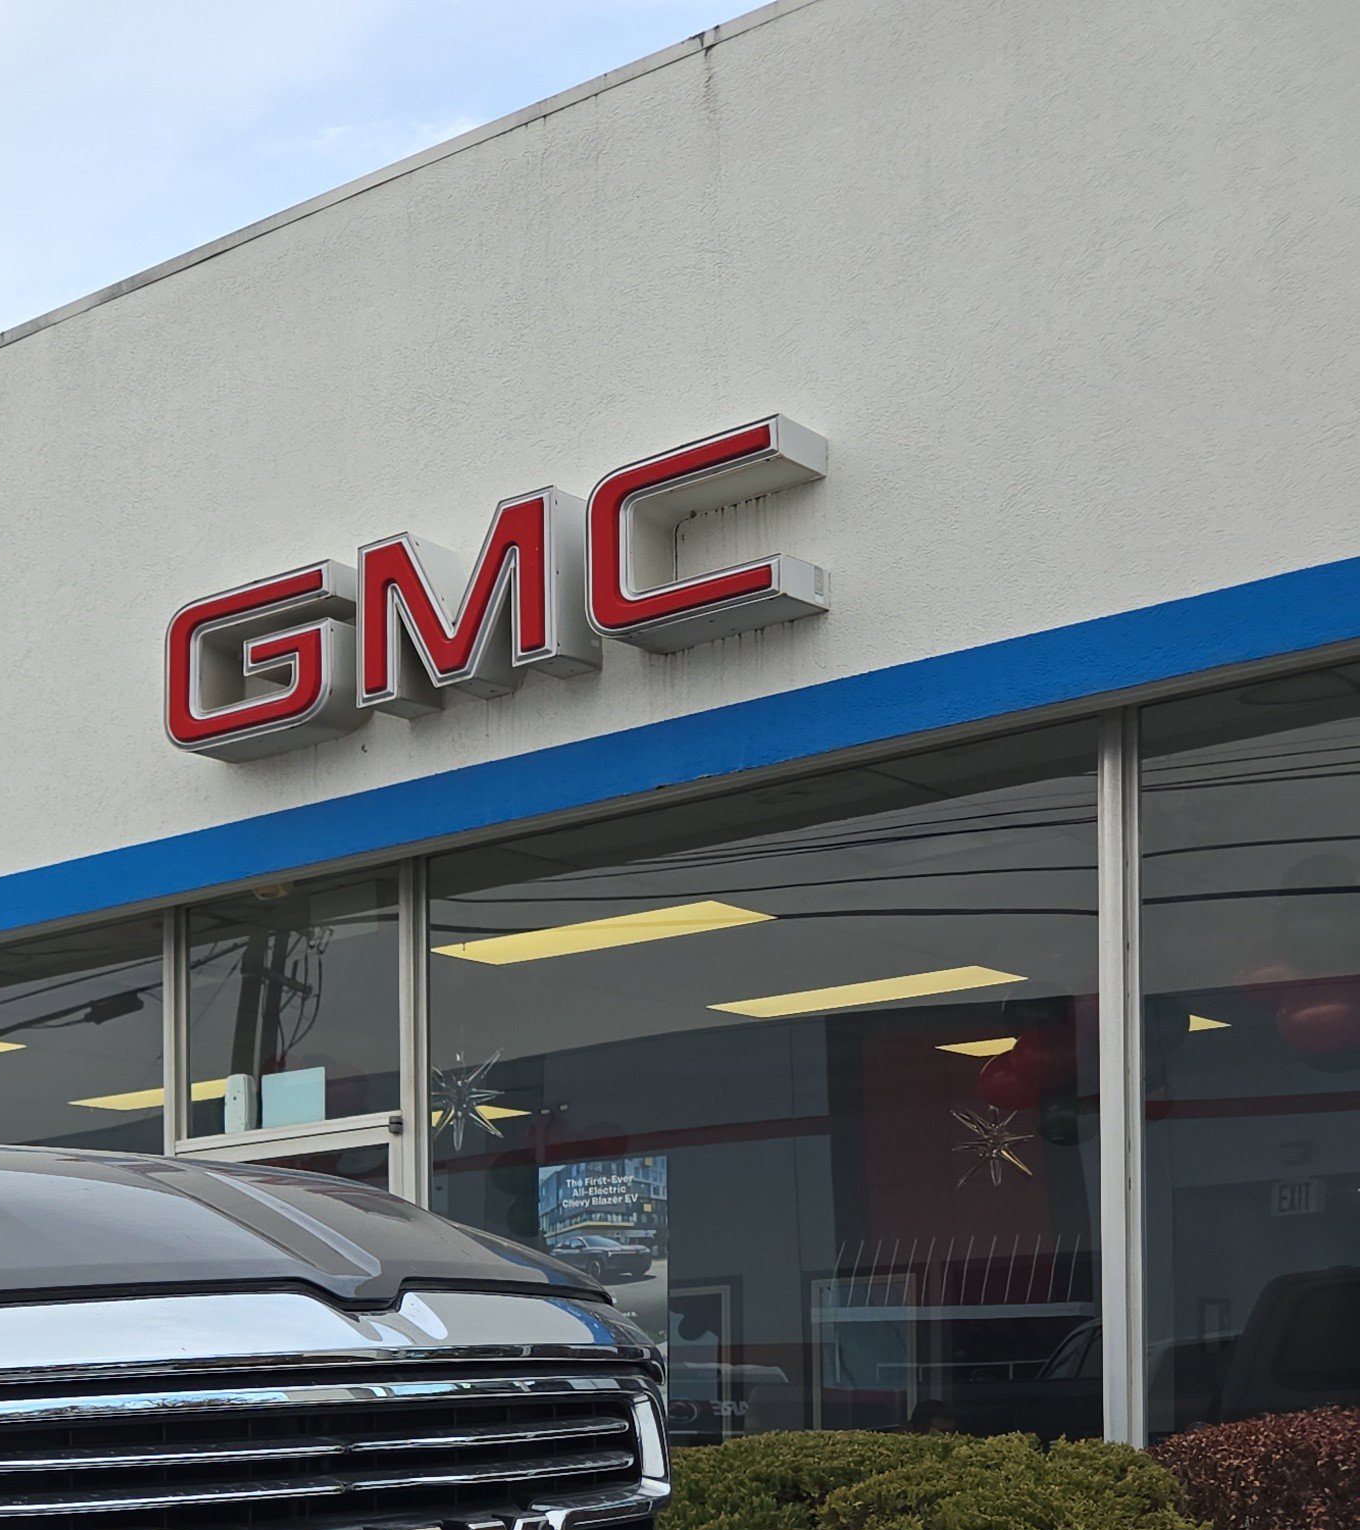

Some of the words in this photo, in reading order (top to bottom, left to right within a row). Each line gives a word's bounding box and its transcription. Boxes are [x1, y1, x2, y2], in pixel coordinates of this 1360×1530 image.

[164, 413, 788, 756] GMC
[565, 1178, 582, 1188] The
[584, 1175, 634, 1186] First-Ever
[572, 1185, 626, 1197] All-Electric
[1278, 1181, 1313, 1213] EXIT
[562, 1198, 590, 1208] Chevy
[592, 1195, 622, 1206] Blazer
[624, 1193, 638, 1203] EV
